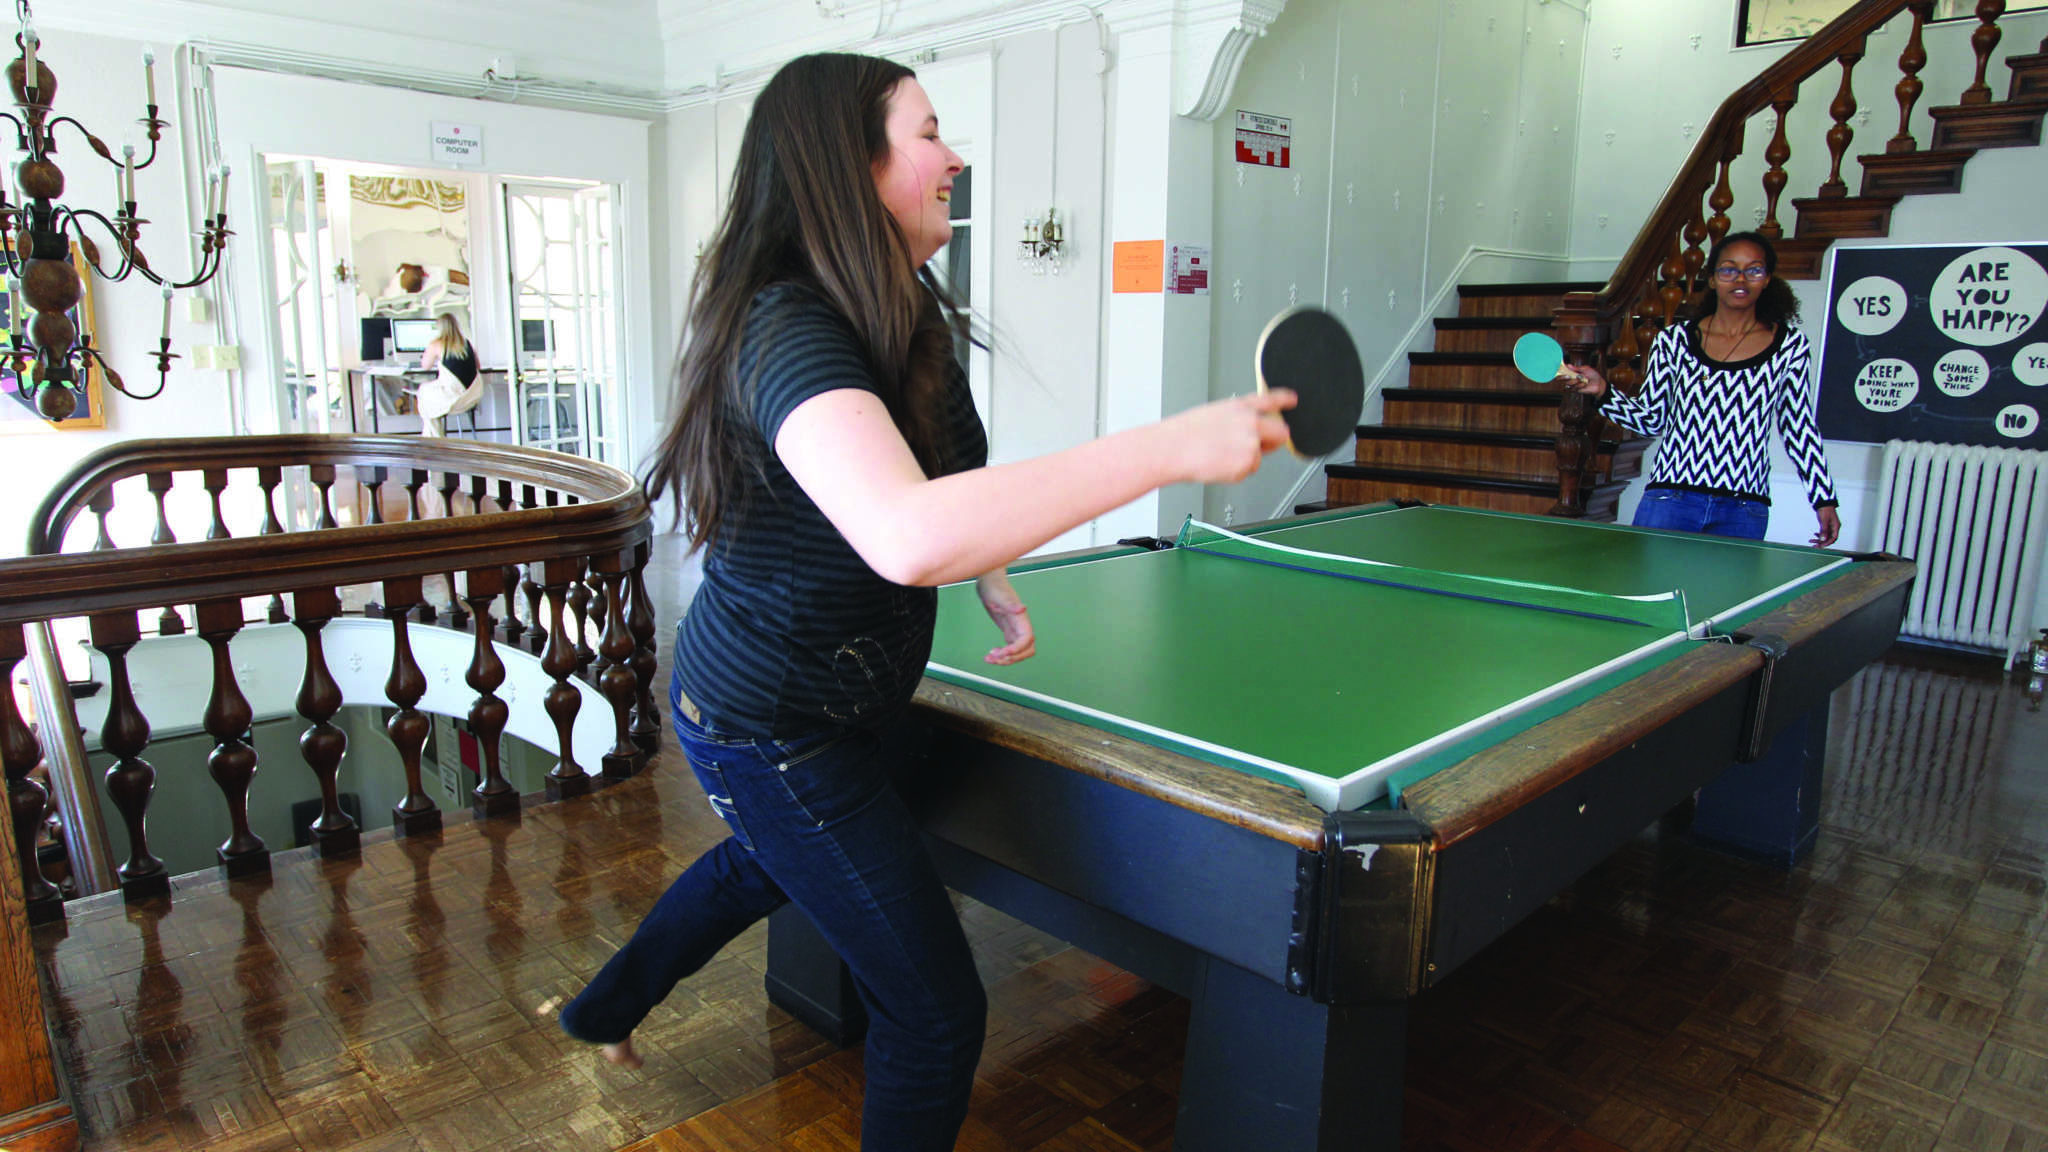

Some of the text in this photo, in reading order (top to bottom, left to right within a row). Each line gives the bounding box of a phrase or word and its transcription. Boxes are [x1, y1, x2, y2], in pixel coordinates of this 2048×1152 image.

[1958, 262, 2009, 283] ARE
[1956, 289, 2009, 305] YOU
[1853, 296, 1891, 316] YES
[1943, 309, 2030, 334] HAPPY?
[1869, 365, 1902, 378] KEEP
[1940, 363, 1979, 374] CHANGE
[1858, 378, 1888, 388] DOING
[1943, 382, 1970, 391] THING
[1866, 398, 1898, 406] DOING
[2003, 413, 2028, 430] NO
